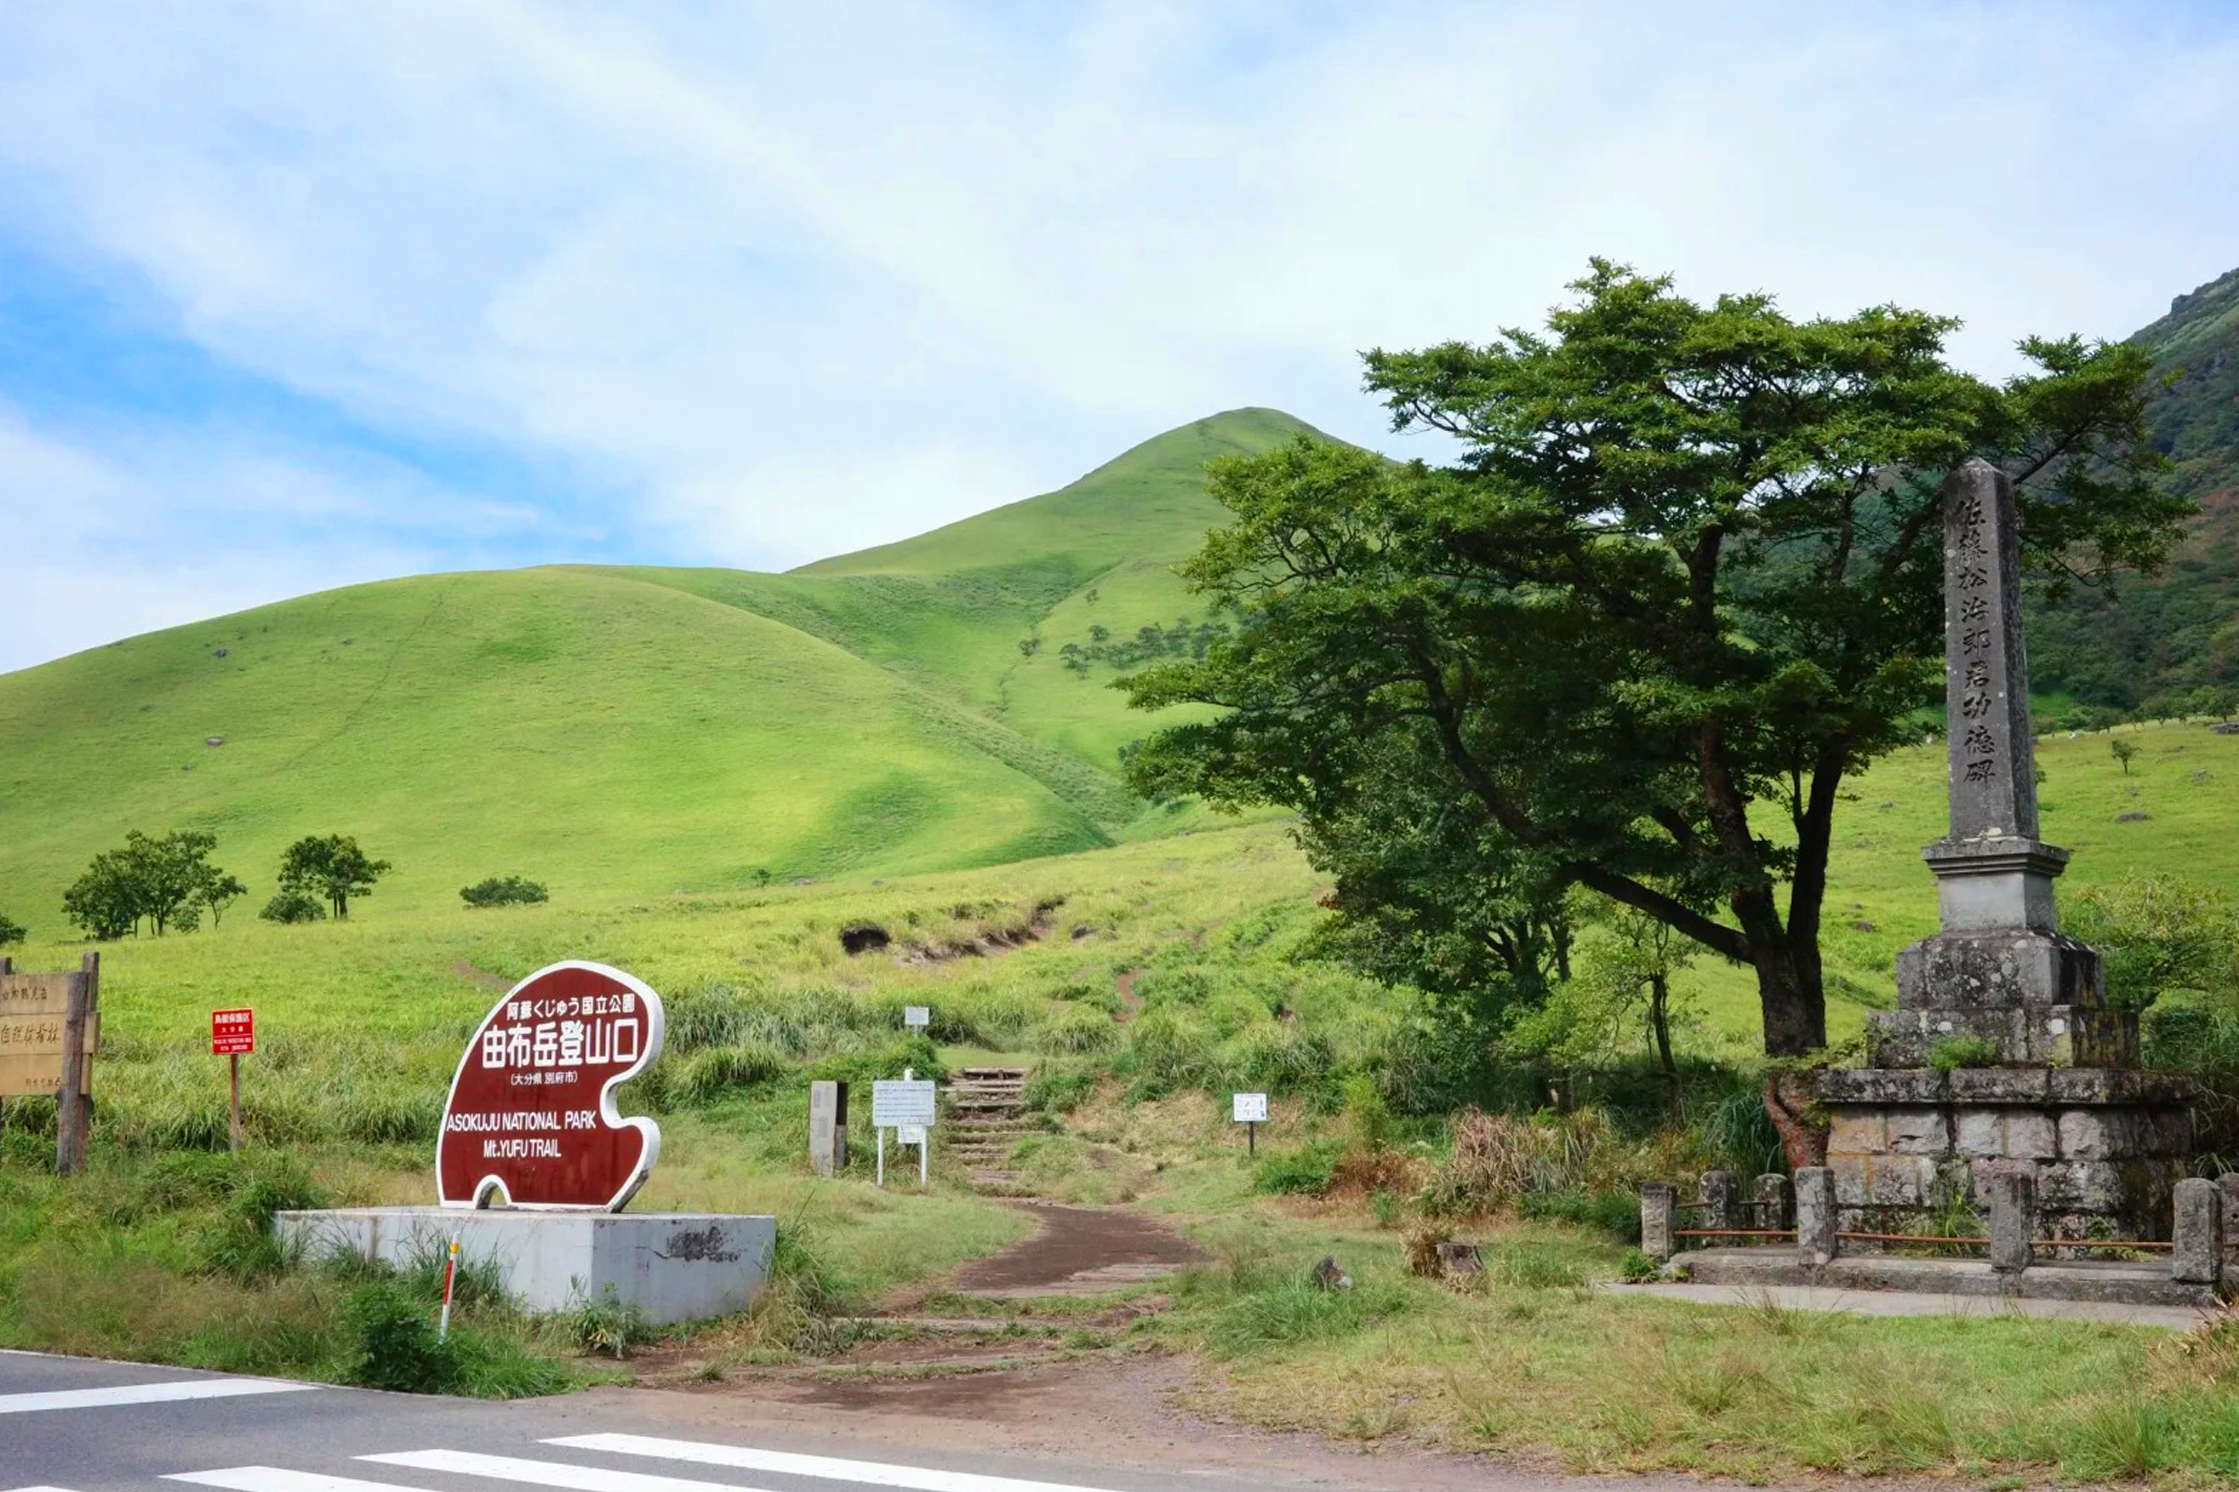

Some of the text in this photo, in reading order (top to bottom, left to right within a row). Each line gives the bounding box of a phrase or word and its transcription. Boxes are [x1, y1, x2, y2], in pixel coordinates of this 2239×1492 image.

[507, 993, 635, 1021] 阿蘇くじゅう国立公園
[482, 1017, 639, 1069] 由布岳登山口
[446, 1110, 597, 1132] ASOKUJU NATIONAL PARK
[529, 1138, 562, 1157] TRAIL
